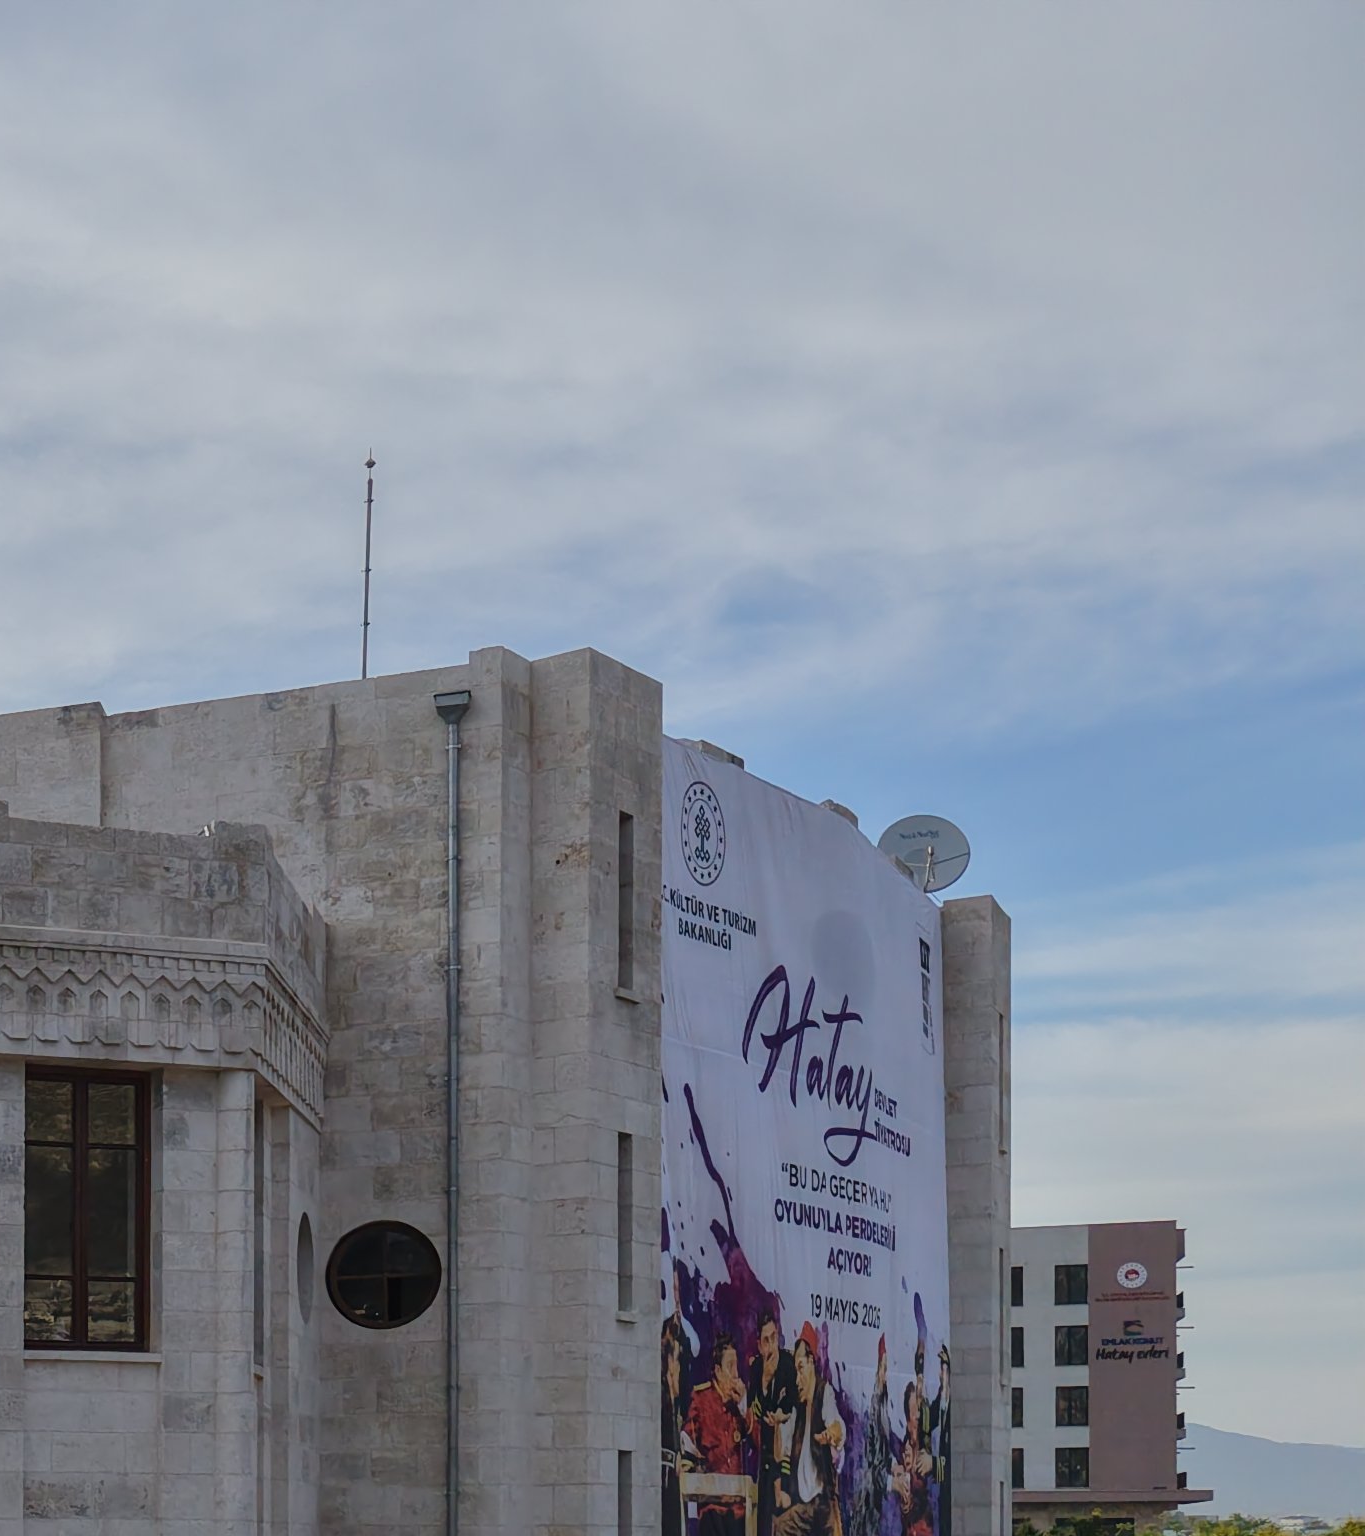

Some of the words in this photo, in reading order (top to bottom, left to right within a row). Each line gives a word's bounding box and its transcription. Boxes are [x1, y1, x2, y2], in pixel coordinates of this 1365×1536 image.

[670, 888, 705, 919] KÜLTÜR
[706, 903, 720, 923] VE
[722, 908, 757, 937] TURİZM
[678, 917, 732, 951] BAKANLIĞI
[742, 965, 878, 1167] Hatay
[811, 1169, 827, 1193] DA
[829, 1175, 868, 1205] GEÇER
[810, 1293, 822, 1318] 19
[824, 1296, 859, 1325] MAYIS
